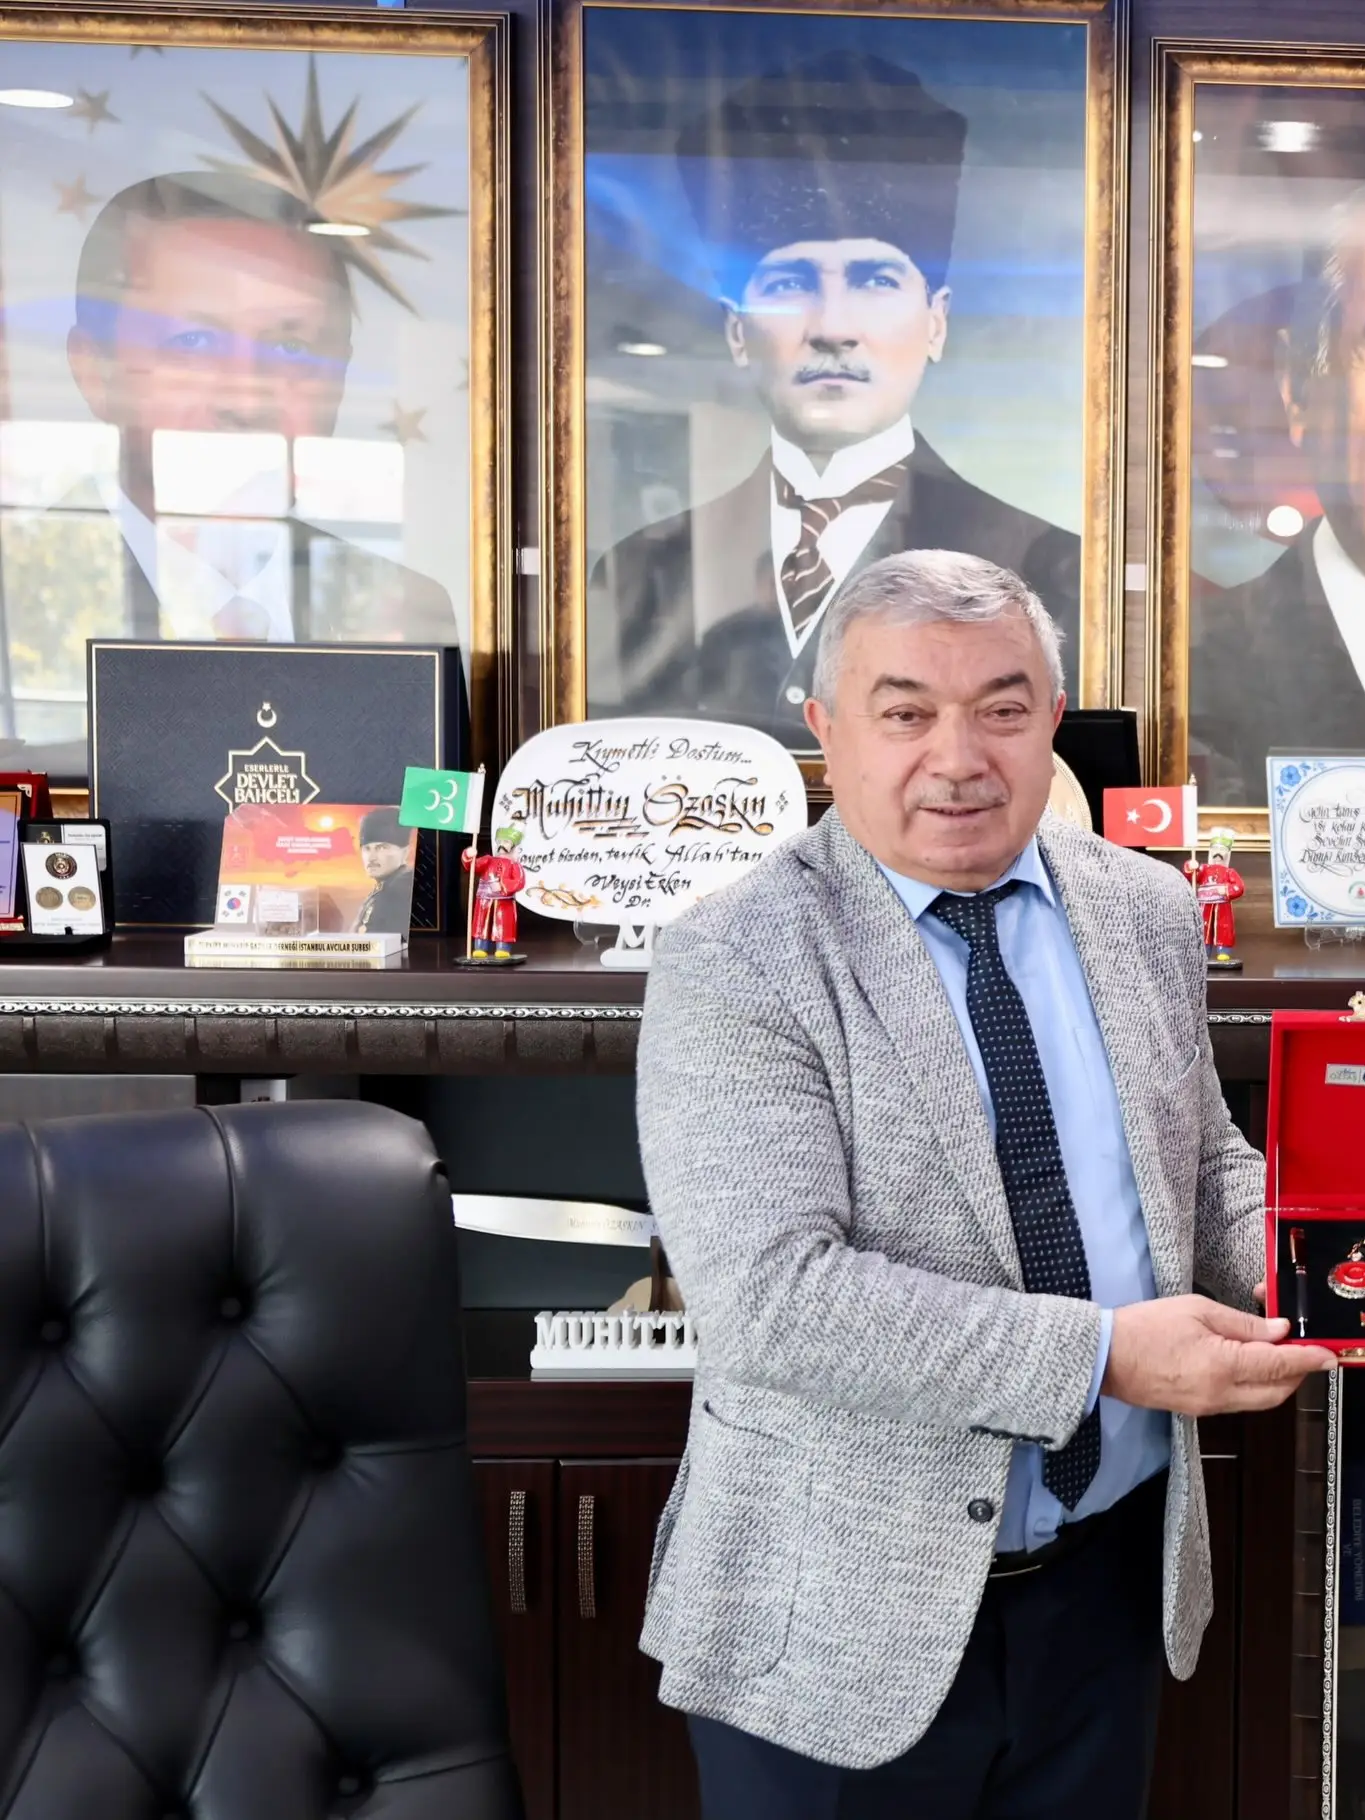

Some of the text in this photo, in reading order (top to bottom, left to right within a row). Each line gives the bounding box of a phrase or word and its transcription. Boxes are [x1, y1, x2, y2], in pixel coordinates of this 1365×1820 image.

[236, 772, 298, 789] DEVLET
[234, 787, 300, 804] BAHÇELİ
[511, 773, 774, 840] Muhittin Özaşkın
[519, 847, 556, 872] ayret
